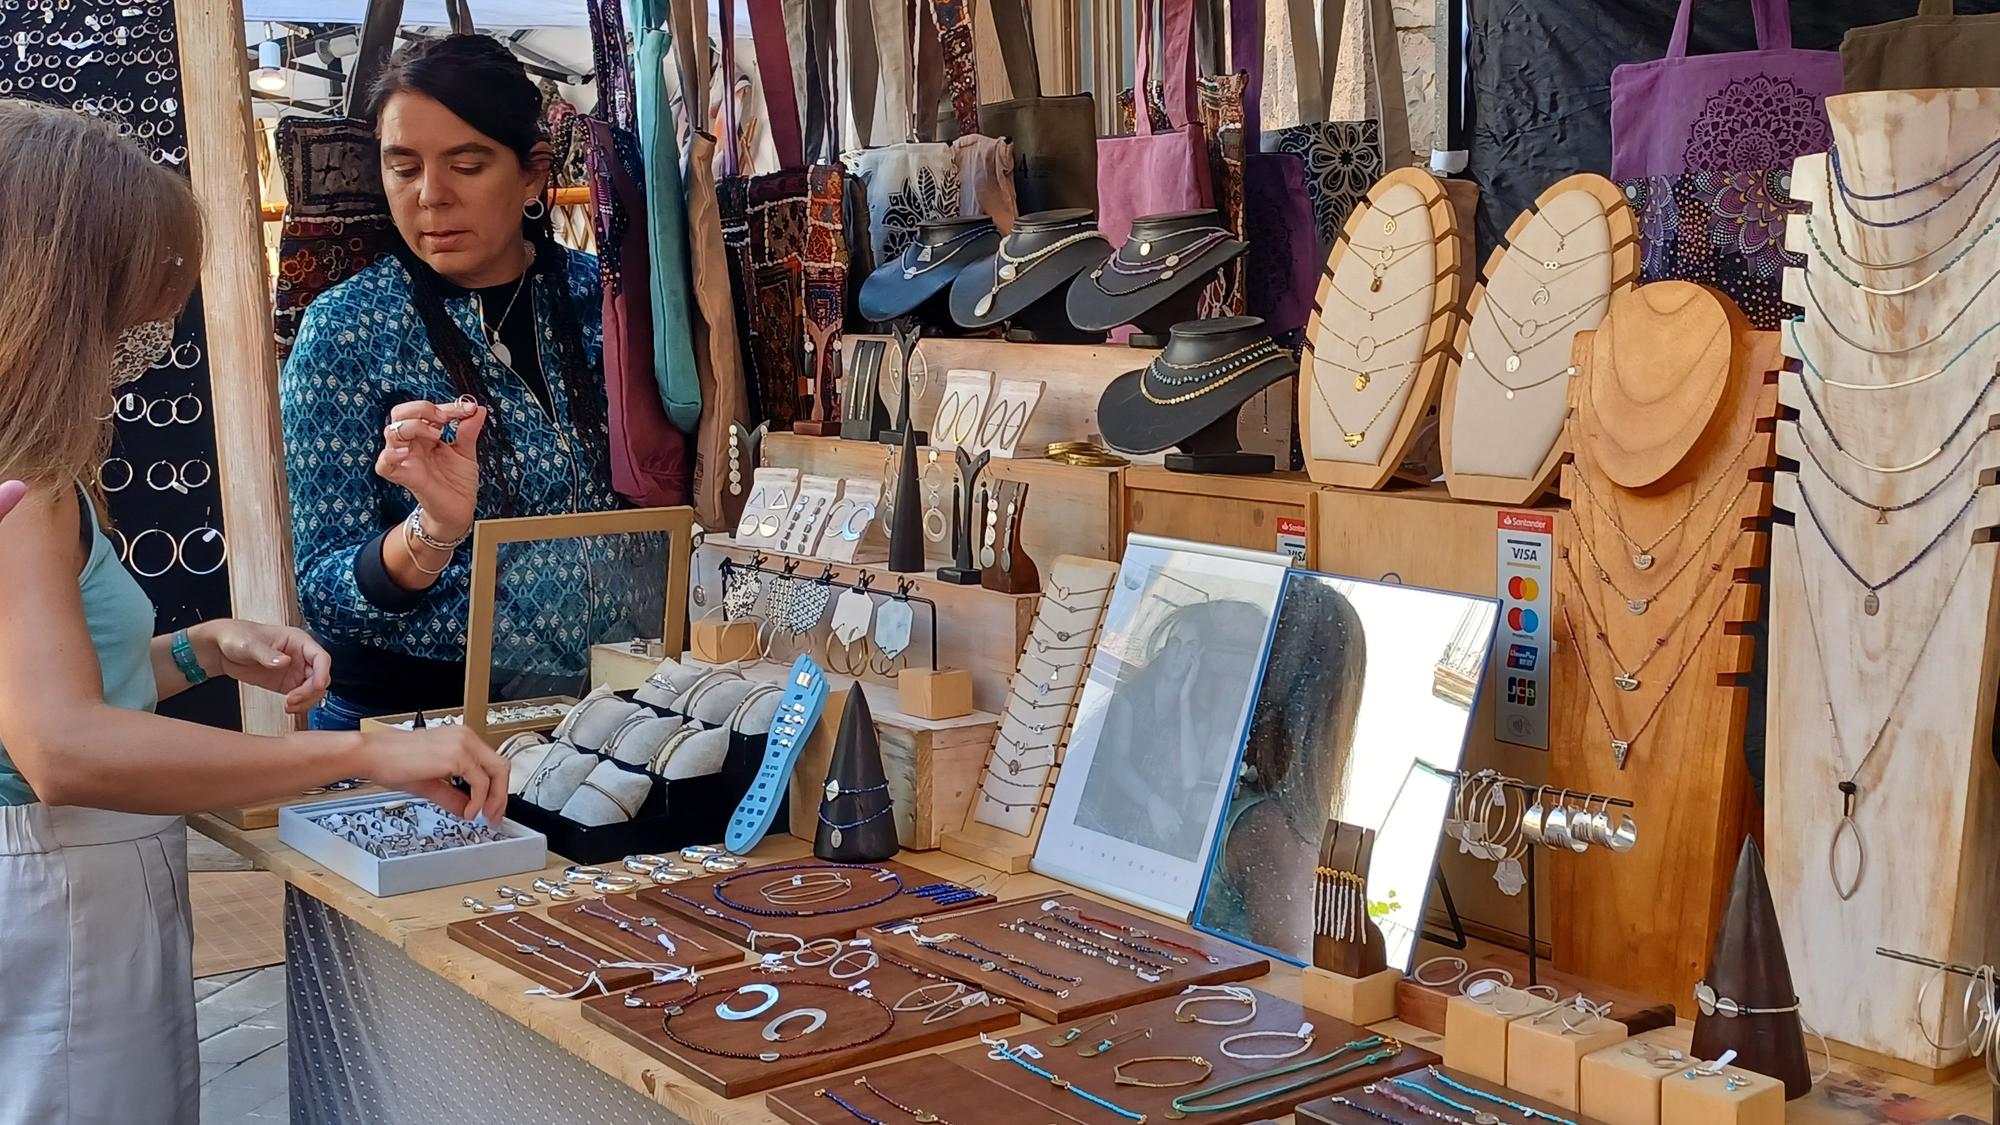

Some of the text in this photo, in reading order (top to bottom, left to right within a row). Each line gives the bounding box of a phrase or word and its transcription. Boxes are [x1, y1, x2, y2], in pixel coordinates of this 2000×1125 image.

[1512, 517, 1546, 529] Santander
[1512, 547, 1538, 561] VISA
[1508, 685, 1535, 698] JCB
